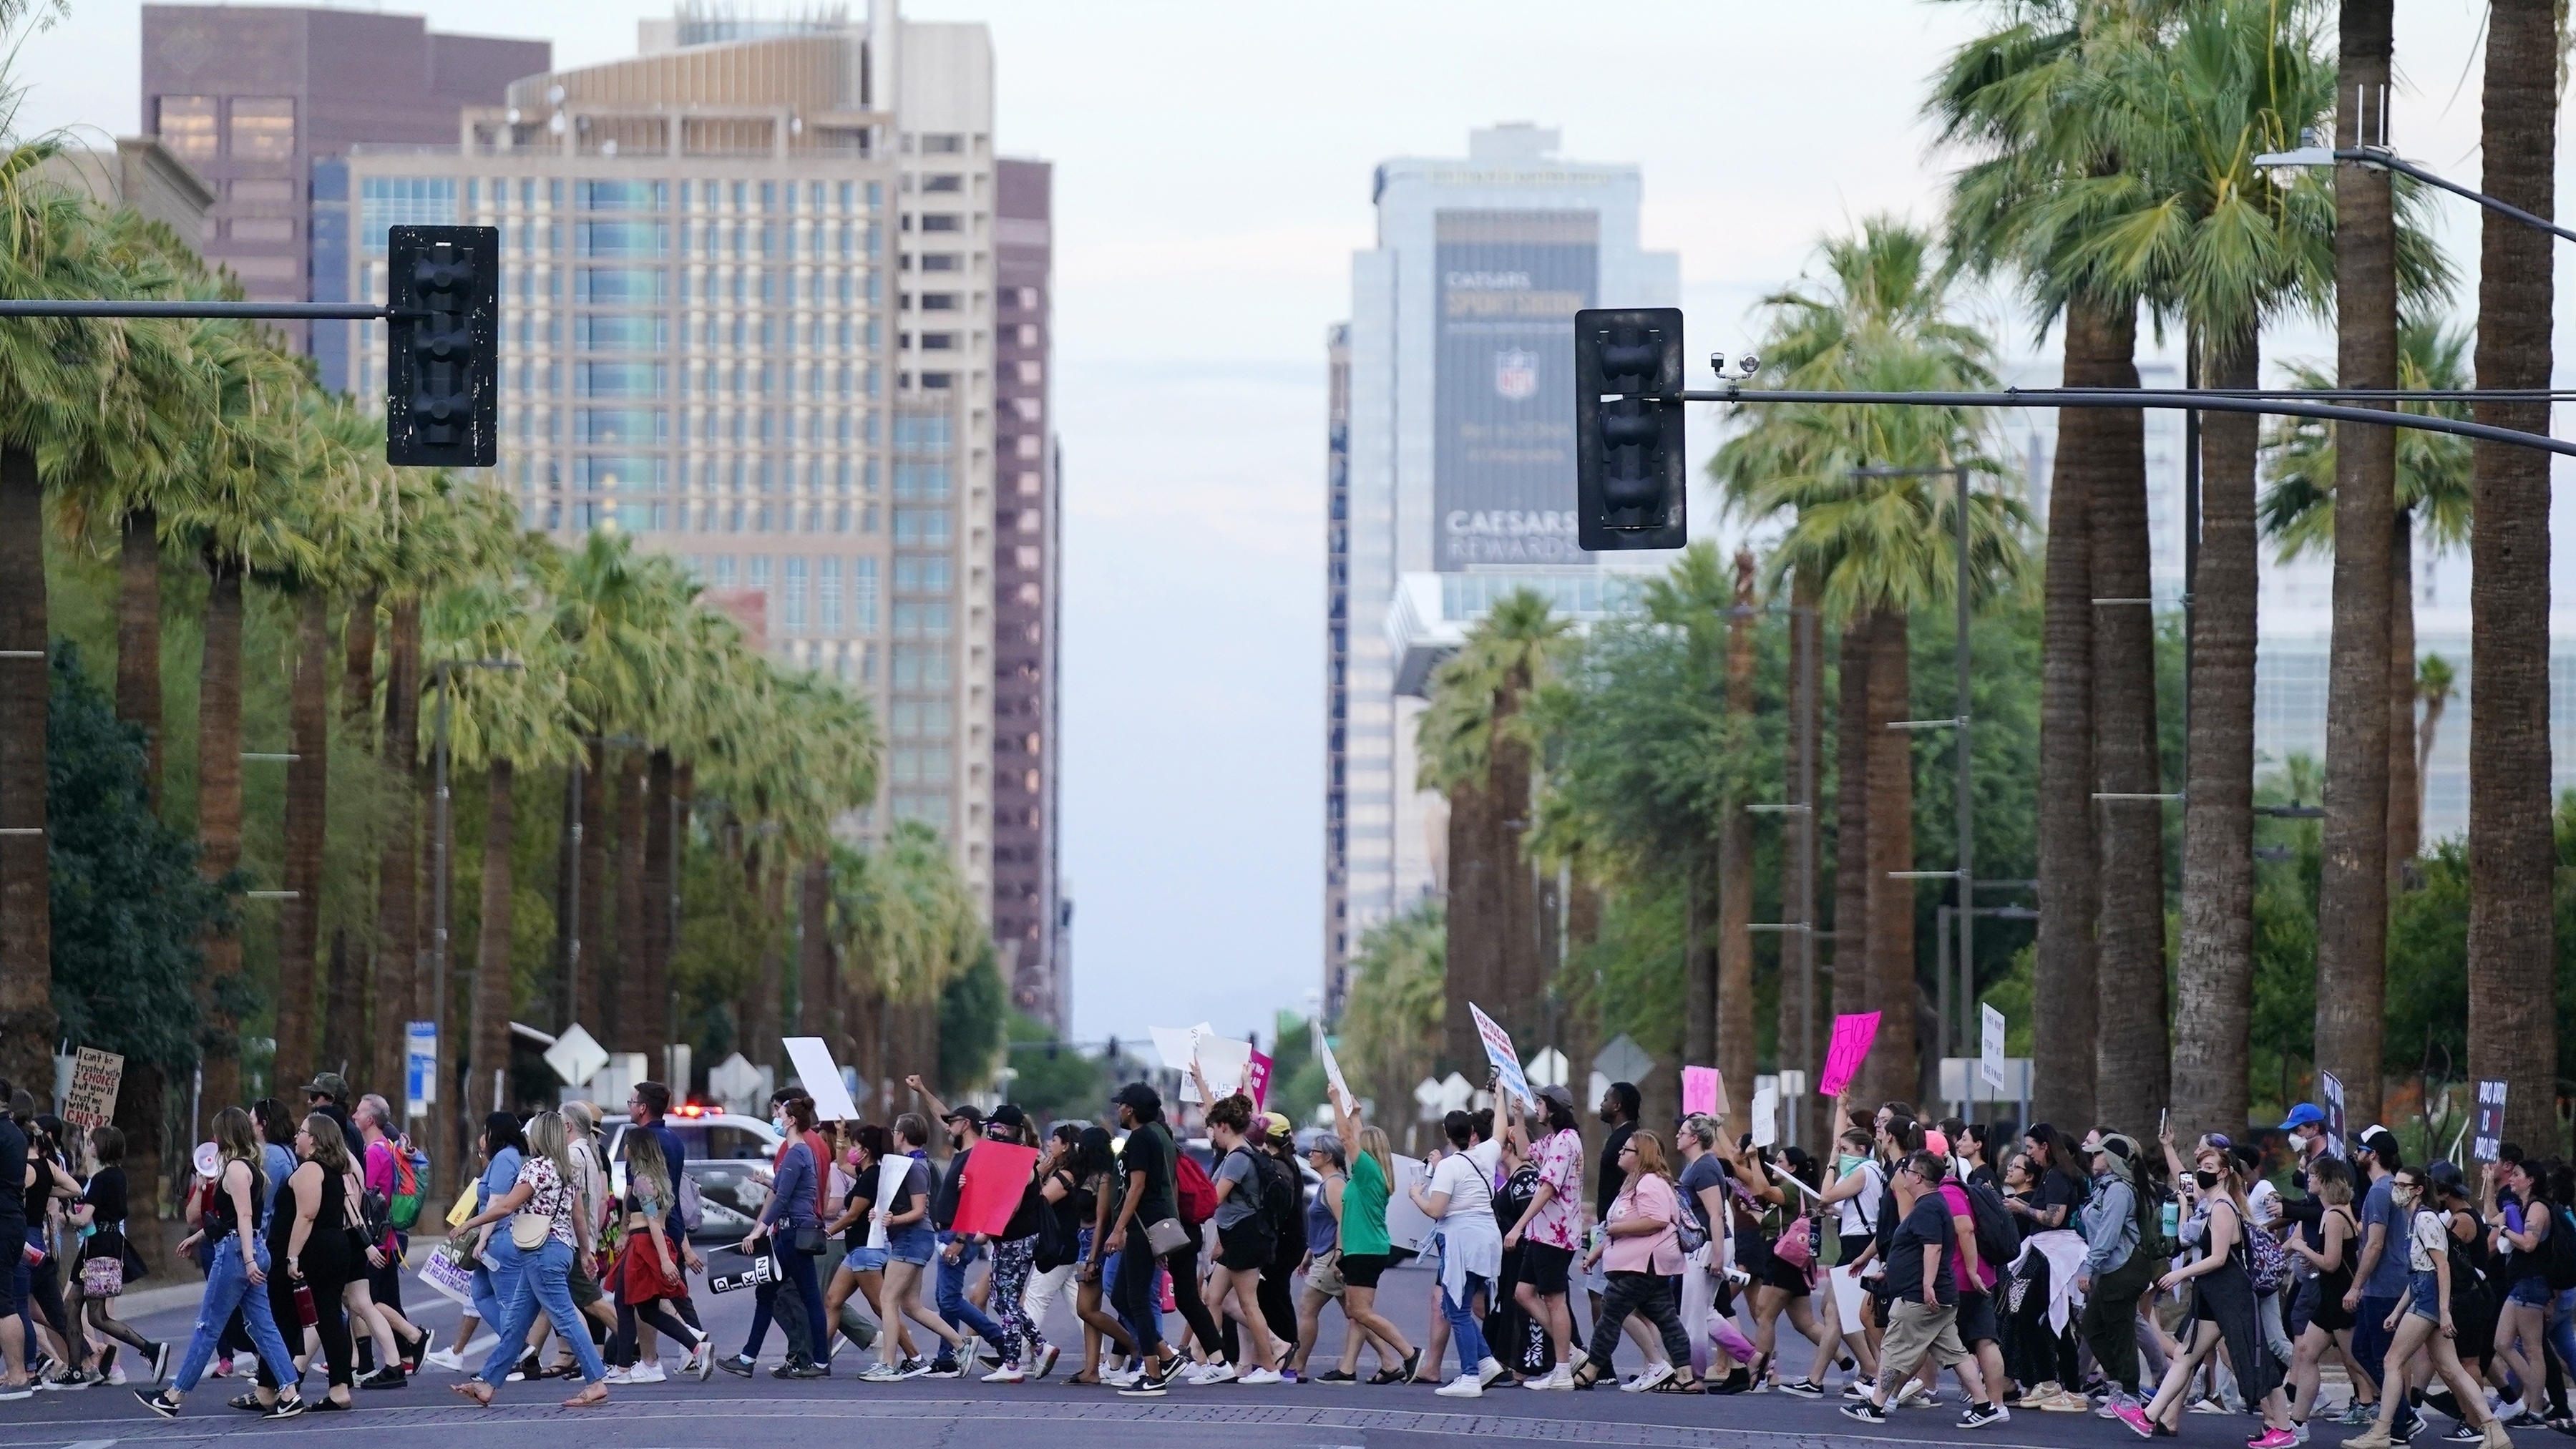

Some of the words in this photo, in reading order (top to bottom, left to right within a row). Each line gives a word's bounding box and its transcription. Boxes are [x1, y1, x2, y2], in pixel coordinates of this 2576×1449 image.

[1446, 509, 1579, 537] CAESARS
[1446, 537, 1580, 562] REWARDS
[79, 1048, 82, 1060] I
[104, 1055, 114, 1065] be
[74, 1070, 79, 1079] a
[82, 1072, 116, 1087] CHOICE
[76, 1060, 105, 1074] trusted
[105, 1068, 120, 1078] with
[72, 1079, 88, 1091] but
[2323, 1073, 2334, 1101] PRO
[2479, 1080, 2493, 1103] PRO
[68, 1101, 90, 1113] with
[94, 1106, 100, 1114] a
[69, 1089, 92, 1103] trust
[92, 1097, 103, 1106] me
[2482, 1109, 2490, 1131] IS
[2327, 1131, 2337, 1158] PRO
[2474, 1136, 2488, 1159] PRO
